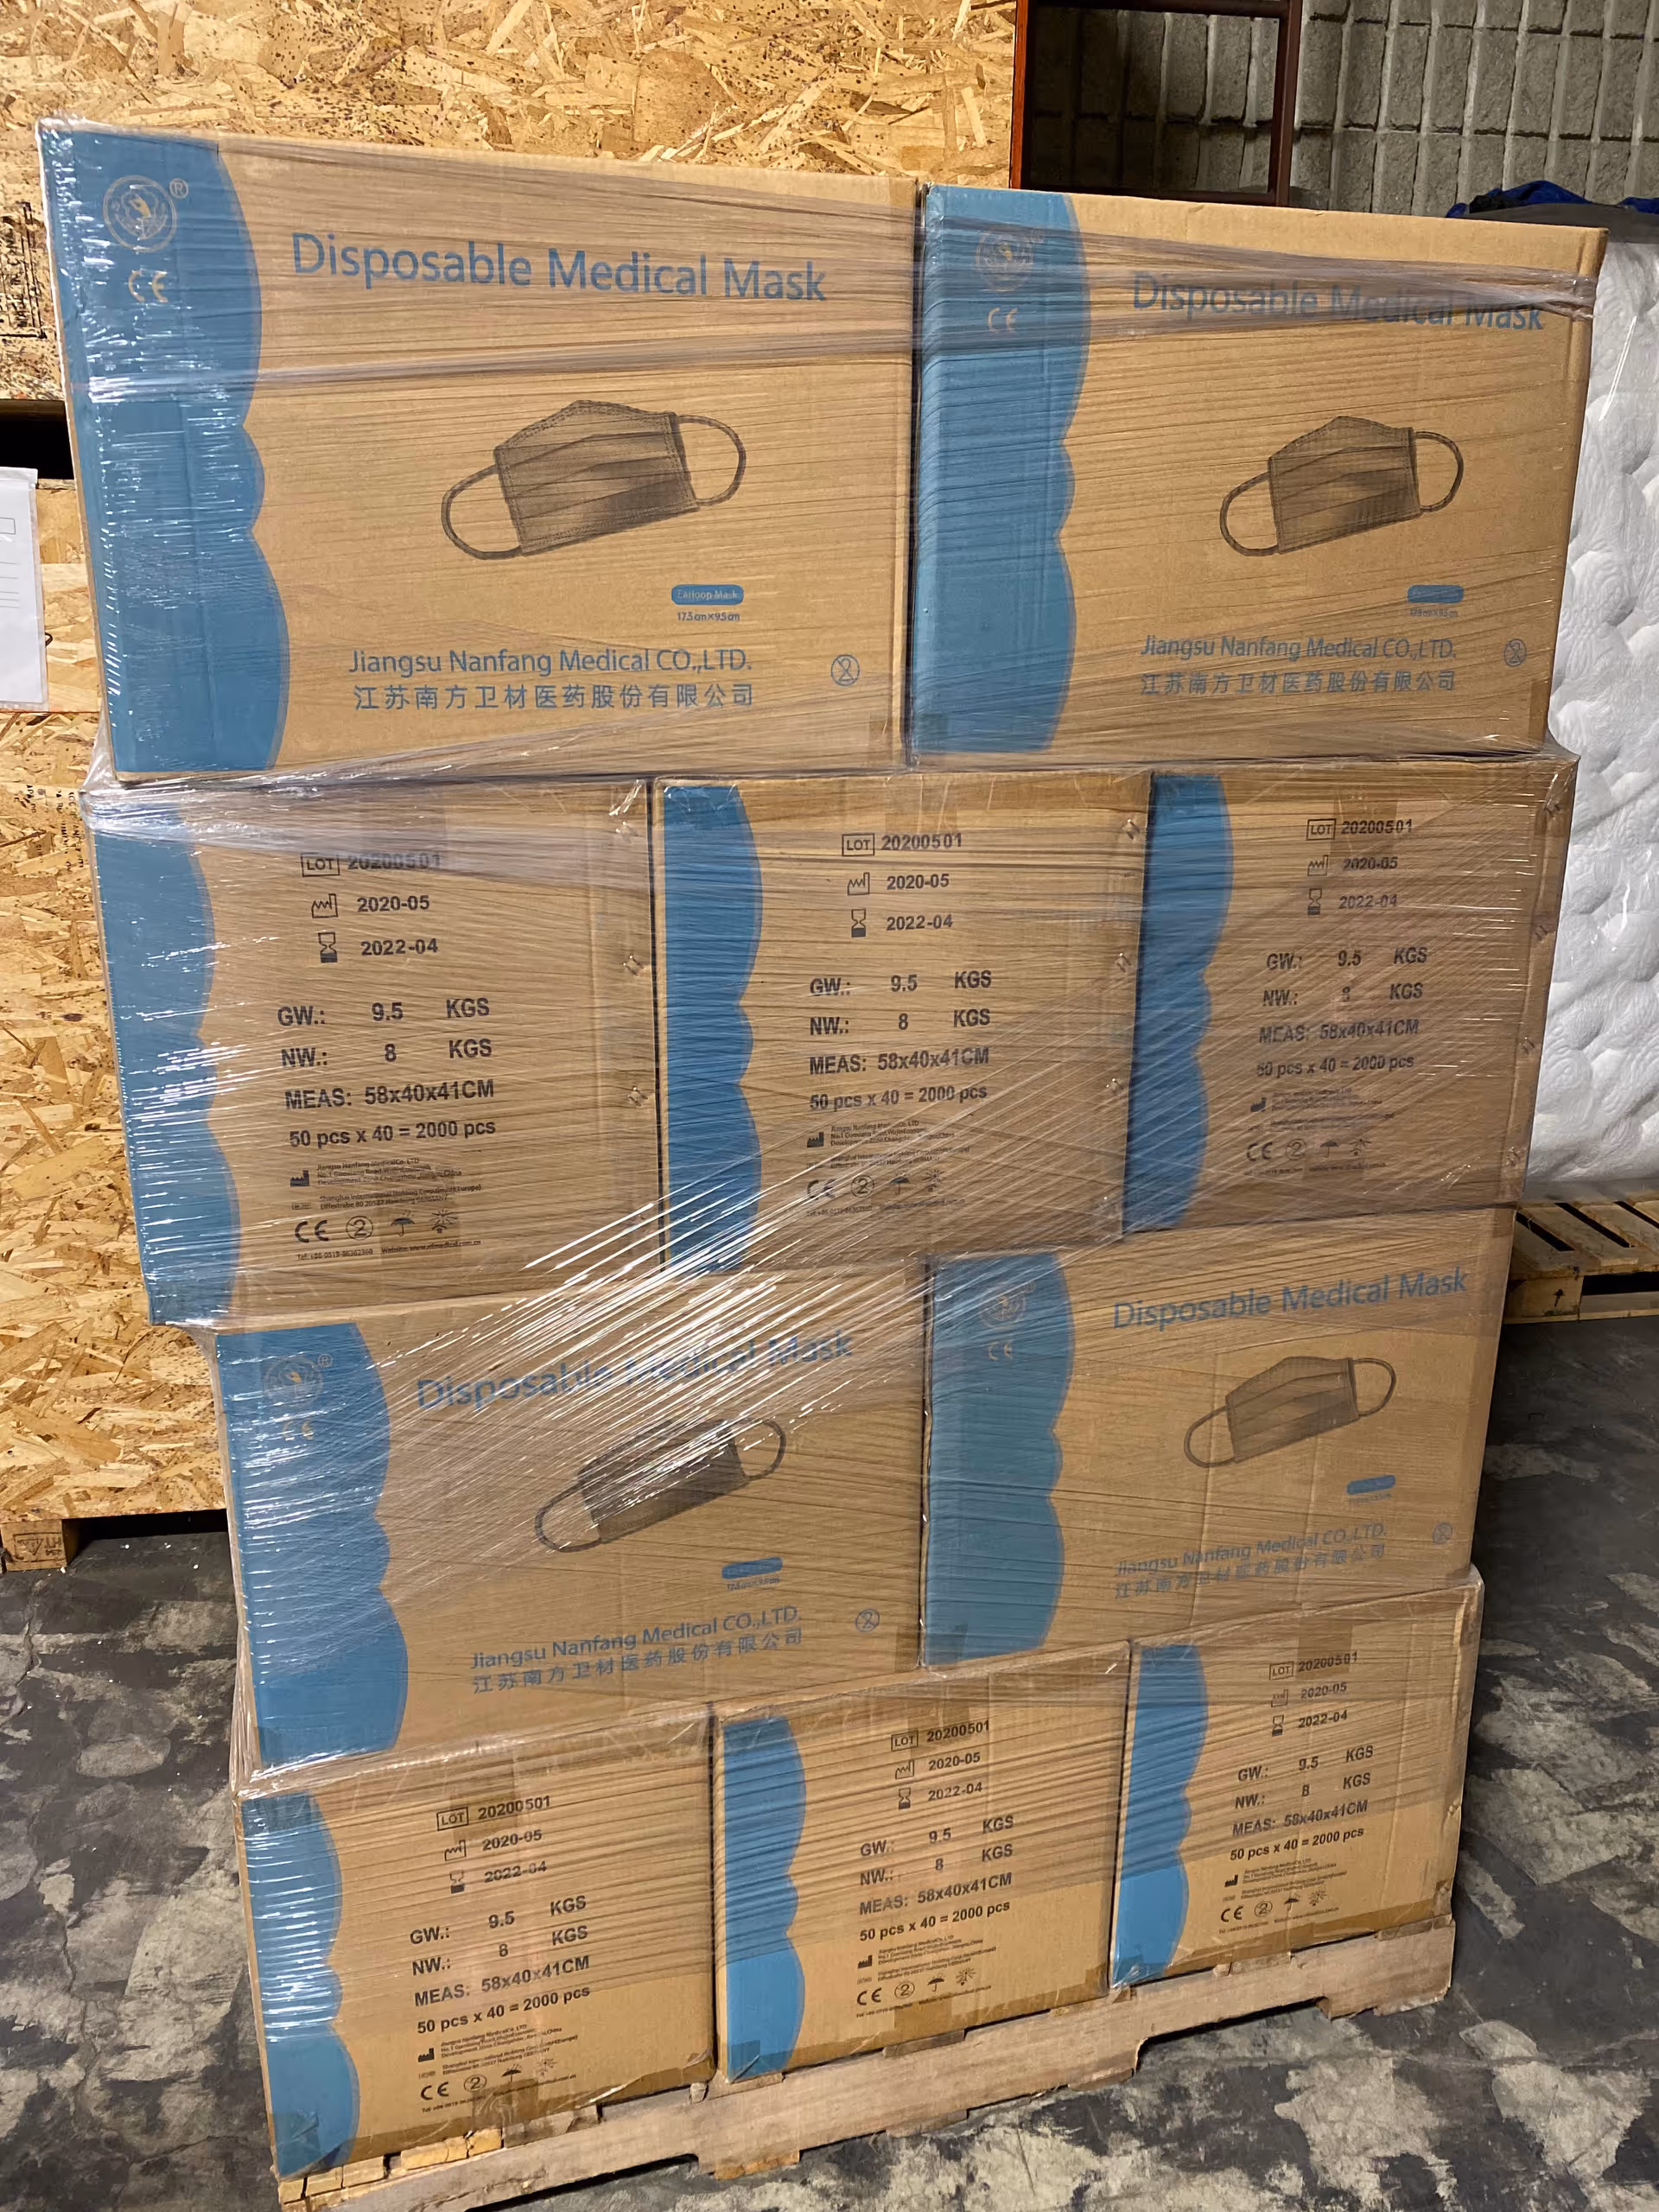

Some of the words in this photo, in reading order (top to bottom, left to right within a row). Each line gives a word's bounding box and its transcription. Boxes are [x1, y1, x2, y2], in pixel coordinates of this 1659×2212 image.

[291, 232, 531, 289] Disposable
[548, 248, 707, 296] Medical
[724, 257, 825, 301] Mask
[1133, 270, 1317, 320] Disposable
[1141, 635, 1213, 660] Jiangsu
[1221, 636, 1300, 662] Nanfang
[1306, 637, 1376, 658] Medical
[349, 650, 441, 677] Jiangsu
[450, 649, 551, 677] Nanfang
[560, 648, 648, 672] Medical
[354, 683, 753, 710] 江苏南方卫材医药股份有限公司
[1311, 825, 1332, 835] LOT
[1341, 819, 1412, 834] 20200501
[847, 839, 870, 850] LOT
[881, 833, 962, 850] 20200501
[307, 859, 334, 870] LOT
[347, 852, 442, 870] 20200501
[1344, 857, 1398, 871] 2020-05
[887, 874, 949, 890] 2020-05
[357, 894, 429, 912] 2020-05
[1339, 894, 1397, 908] 2022-04
[887, 914, 953, 931] 2022-04
[361, 938, 437, 956] 2022-04
[1338, 950, 1361, 966] 9.5
[1394, 947, 1427, 964] KGS
[891, 975, 918, 992] 9.5
[954, 970, 991, 988] KGS
[1389, 982, 1423, 1000] KGS
[372, 1002, 404, 1021] 9.5
[446, 998, 490, 1018] KGS
[899, 1014, 908, 1030] 8
[954, 1008, 990, 1027] KGS
[385, 1043, 397, 1062] 8
[449, 1039, 492, 1058] KGS
[810, 1054, 866, 1074] MEAS:
[878, 1046, 988, 1070] 58x40x41CM
[1277, 1063, 1302, 1077] pcs
[1306, 1063, 1315, 1073] x
[1319, 1058, 1336, 1072] 40
[1353, 1055, 1384, 1070] 2000
[1389, 1056, 1414, 1071] pcs
[285, 1088, 352, 1109] MEAS:
[365, 1079, 493, 1104] 58x40x41CM
[810, 1094, 828, 1109] 50
[834, 1095, 861, 1111] pcs
[868, 1094, 876, 1106] x
[881, 1090, 899, 1105] 40
[918, 1086, 954, 1103] 2000
[960, 1087, 987, 1103] pcs
[289, 1130, 311, 1147] 50
[317, 1131, 350, 1148] pcs
[357, 1129, 366, 1142] x
[372, 1125, 393, 1141] 40
[416, 1121, 457, 1138] 2000
[464, 1122, 496, 1138] pcs
[1246, 1142, 1273, 1161] CE
[295, 1220, 328, 1243] CE
[1113, 1288, 1270, 1332] Disposable
[1281, 1274, 1389, 1312] Medical
[1399, 1267, 1467, 1300] Mask
[1116, 1557, 1177, 1578] Jiangsu
[1183, 1544, 1251, 1565] Nanfang
[1256, 1532, 1318, 1554] Medical
[471, 1646, 546, 1669] Jiangsu
[553, 1632, 637, 1659] Nanfang
[642, 1617, 717, 1644] Medical
[1273, 1666, 1291, 1676] LOT
[1298, 1651, 1357, 1672] 20200501
[1301, 1682, 1347, 1700] 2020-05
[1299, 1710, 1348, 1728] 2022-04
[895, 1736, 915, 1747] LOT
[927, 1719, 989, 1742] 20200501
[929, 1752, 981, 1770] 2020-05
[1299, 1756, 1319, 1770] 9.5
[1345, 1745, 1373, 1763] KGS
[928, 1782, 982, 1801] 2022-04
[1343, 1773, 1370, 1789] KGS
[442, 1813, 465, 1826] LOT
[478, 1796, 550, 1820] 20200501
[1232, 1818, 1275, 1837] MEAS:
[1284, 1800, 1368, 1827] 58x40x41CM
[482, 1829, 542, 1851] 2020-05
[929, 1828, 951, 1843] 9.5
[982, 1815, 1014, 1834] KGS
[1230, 1848, 1244, 1860] 50
[1248, 1846, 1269, 1860] pcs
[1274, 1844, 1280, 1853] x
[1284, 1839, 1298, 1851] 40
[1313, 1831, 1340, 1846] 2000
[1343, 1827, 1363, 1842] pcs
[936, 1859, 944, 1871] 8
[982, 1844, 1013, 1862] KGS
[484, 1861, 547, 1883] 2022-04
[860, 1895, 907, 1915] MEAS:
[918, 1872, 1012, 1904] 58x40x41CM
[488, 1911, 514, 1929] 9.5
[550, 1896, 587, 1916] KGS
[860, 1929, 875, 1942] 50
[880, 1924, 904, 1940] pcs
[909, 1923, 916, 1931] x
[920, 1916, 936, 1929] 40
[952, 1906, 982, 1923] 2000
[987, 1902, 1010, 1917] pcs
[1221, 1905, 1243, 1923] CE
[499, 1943, 508, 1957] 8
[552, 1925, 588, 1946] KGS
[415, 1984, 470, 2007] MEAS:
[481, 1955, 589, 1993] 58x40x41CM
[857, 1988, 881, 2005] CE
[417, 2019, 435, 2034] 50
[441, 2015, 468, 2031] pcs
[474, 2012, 482, 2023] x
[487, 2005, 505, 2019] 40
[524, 1993, 558, 2011] 2000
[564, 1987, 590, 2005] pcs
[420, 2082, 449, 2101] CE
